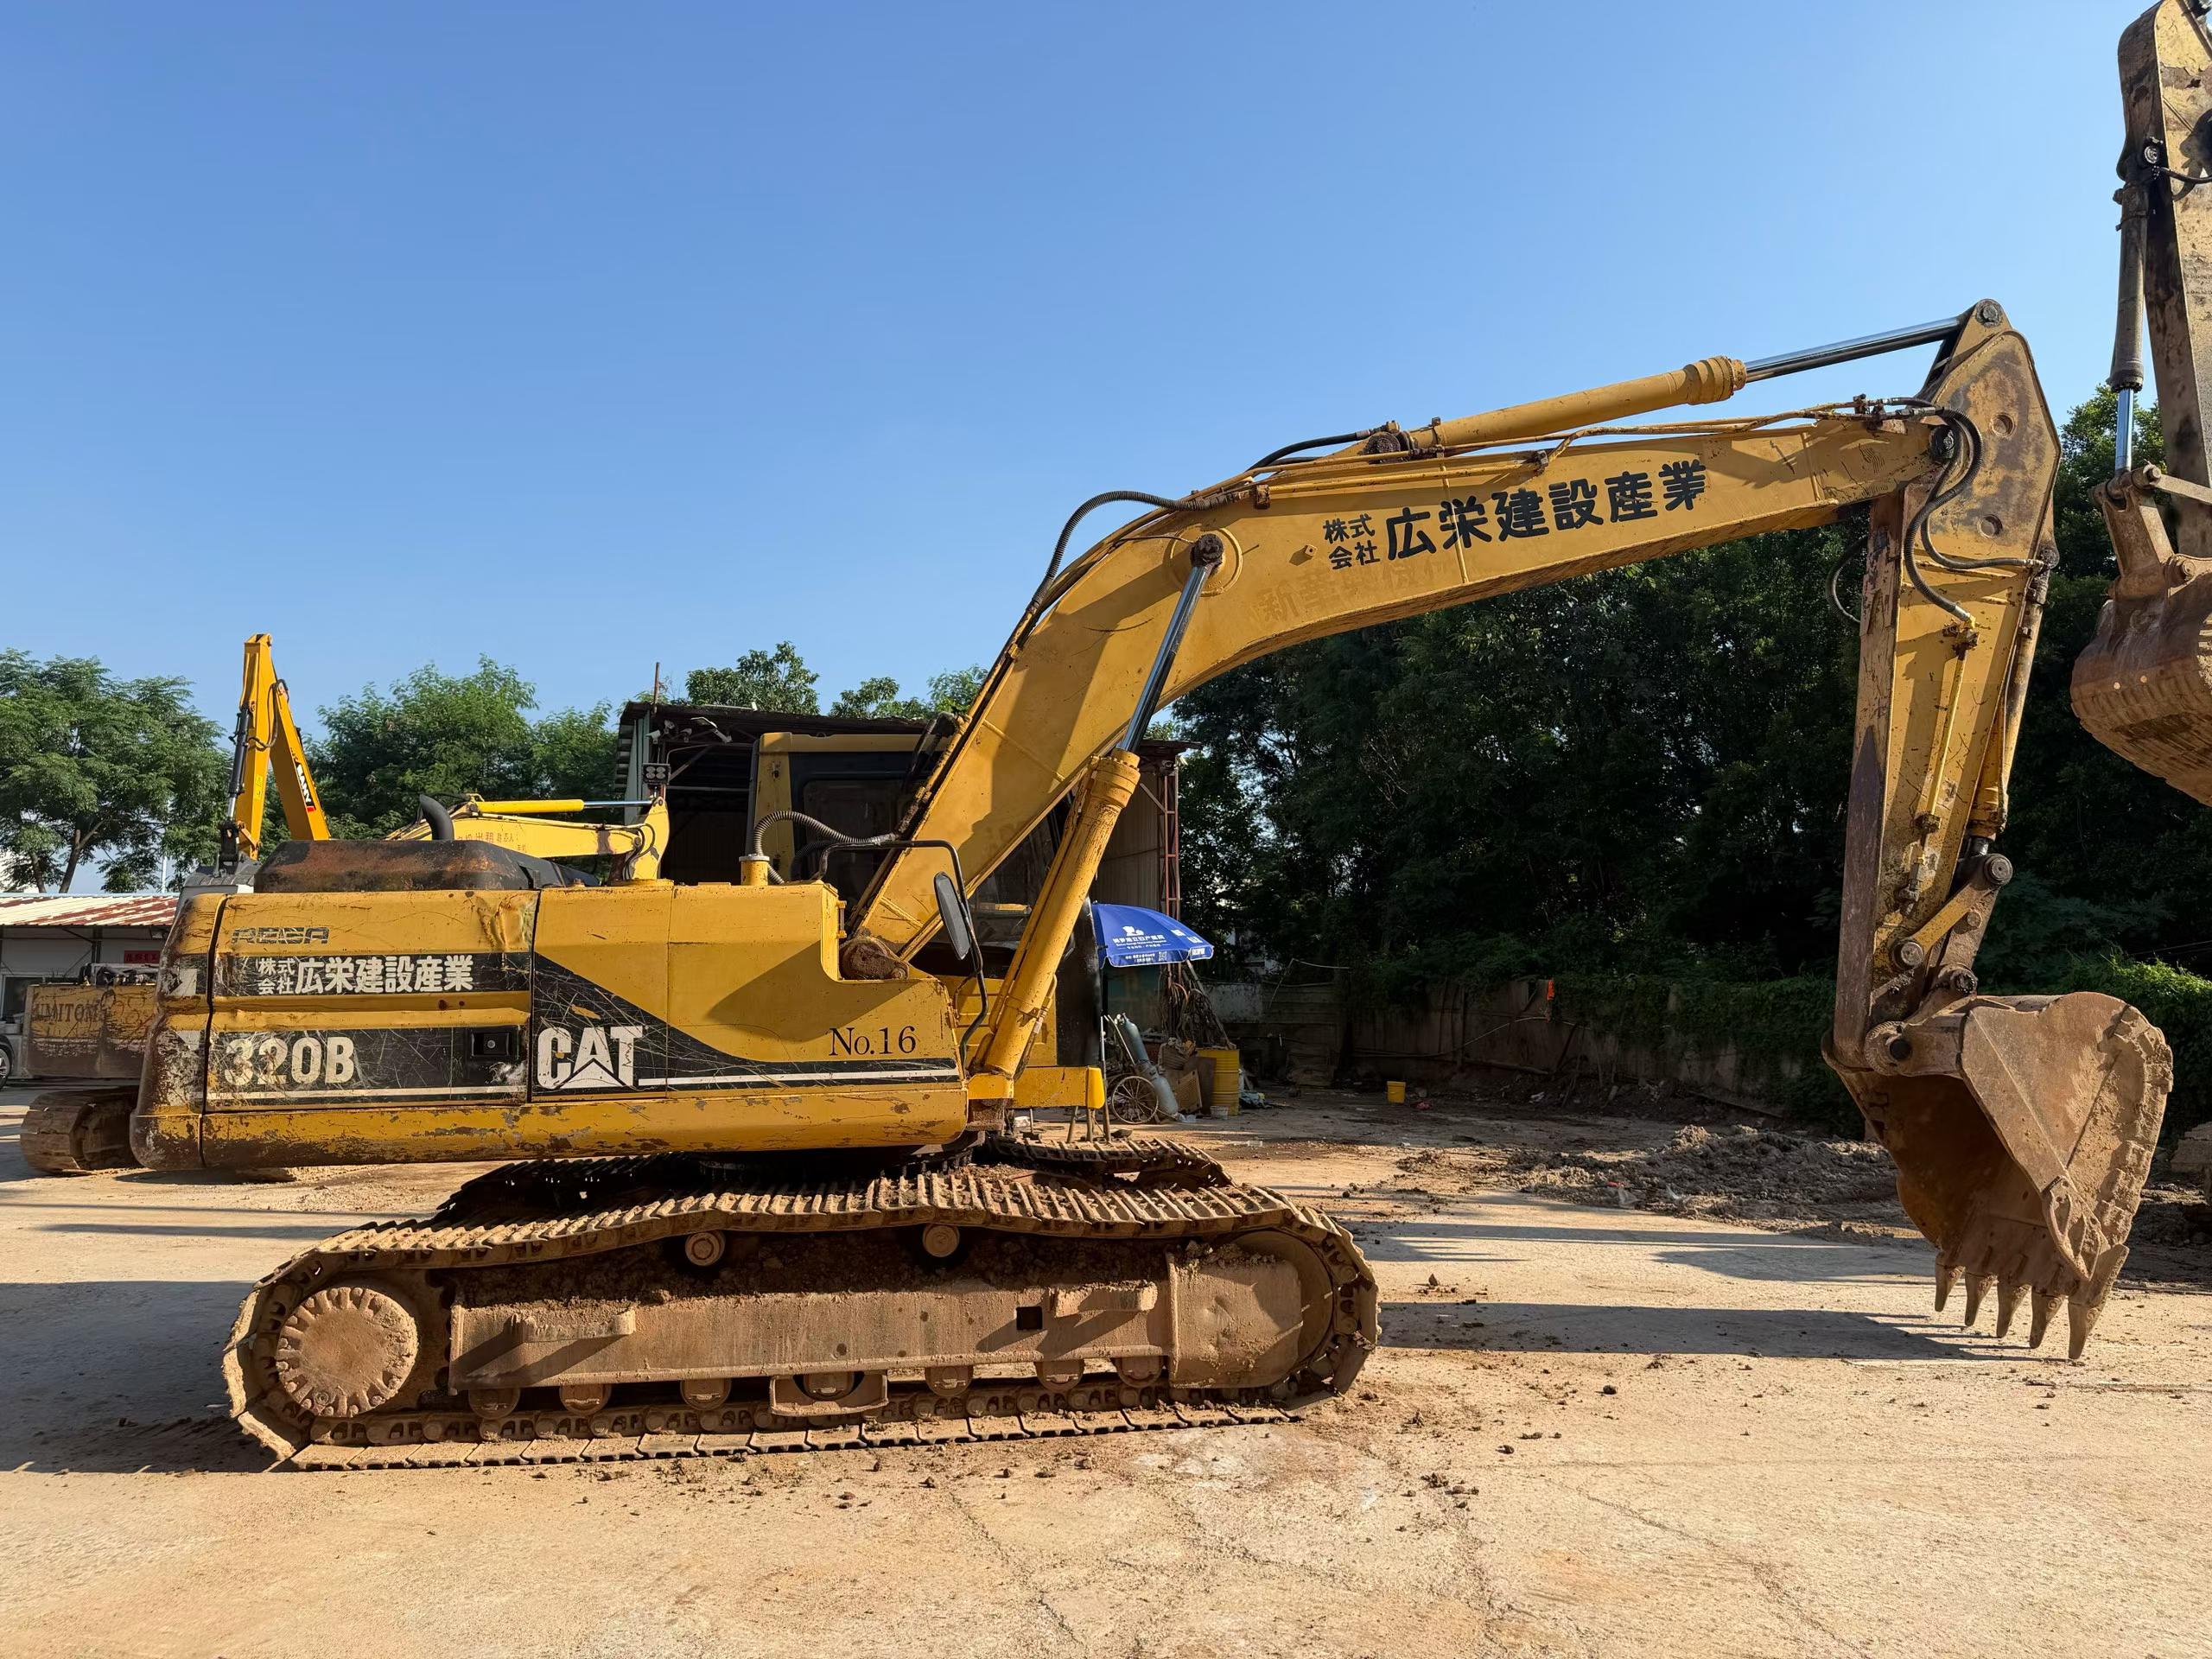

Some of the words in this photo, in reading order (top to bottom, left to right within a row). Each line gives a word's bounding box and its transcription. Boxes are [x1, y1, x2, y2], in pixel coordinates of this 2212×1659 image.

[1385, 459, 1707, 561] 広栄建設産業
[1322, 513, 1376, 545] 株式
[1328, 539, 1381, 570] 会社
[258, 957, 296, 976] 株式
[295, 955, 474, 994] 広栄建設産業
[258, 976, 295, 995] 会社
[829, 1026, 916, 1056] No.16
[224, 1037, 354, 1086] 320B
[537, 1026, 643, 1090] CAT
